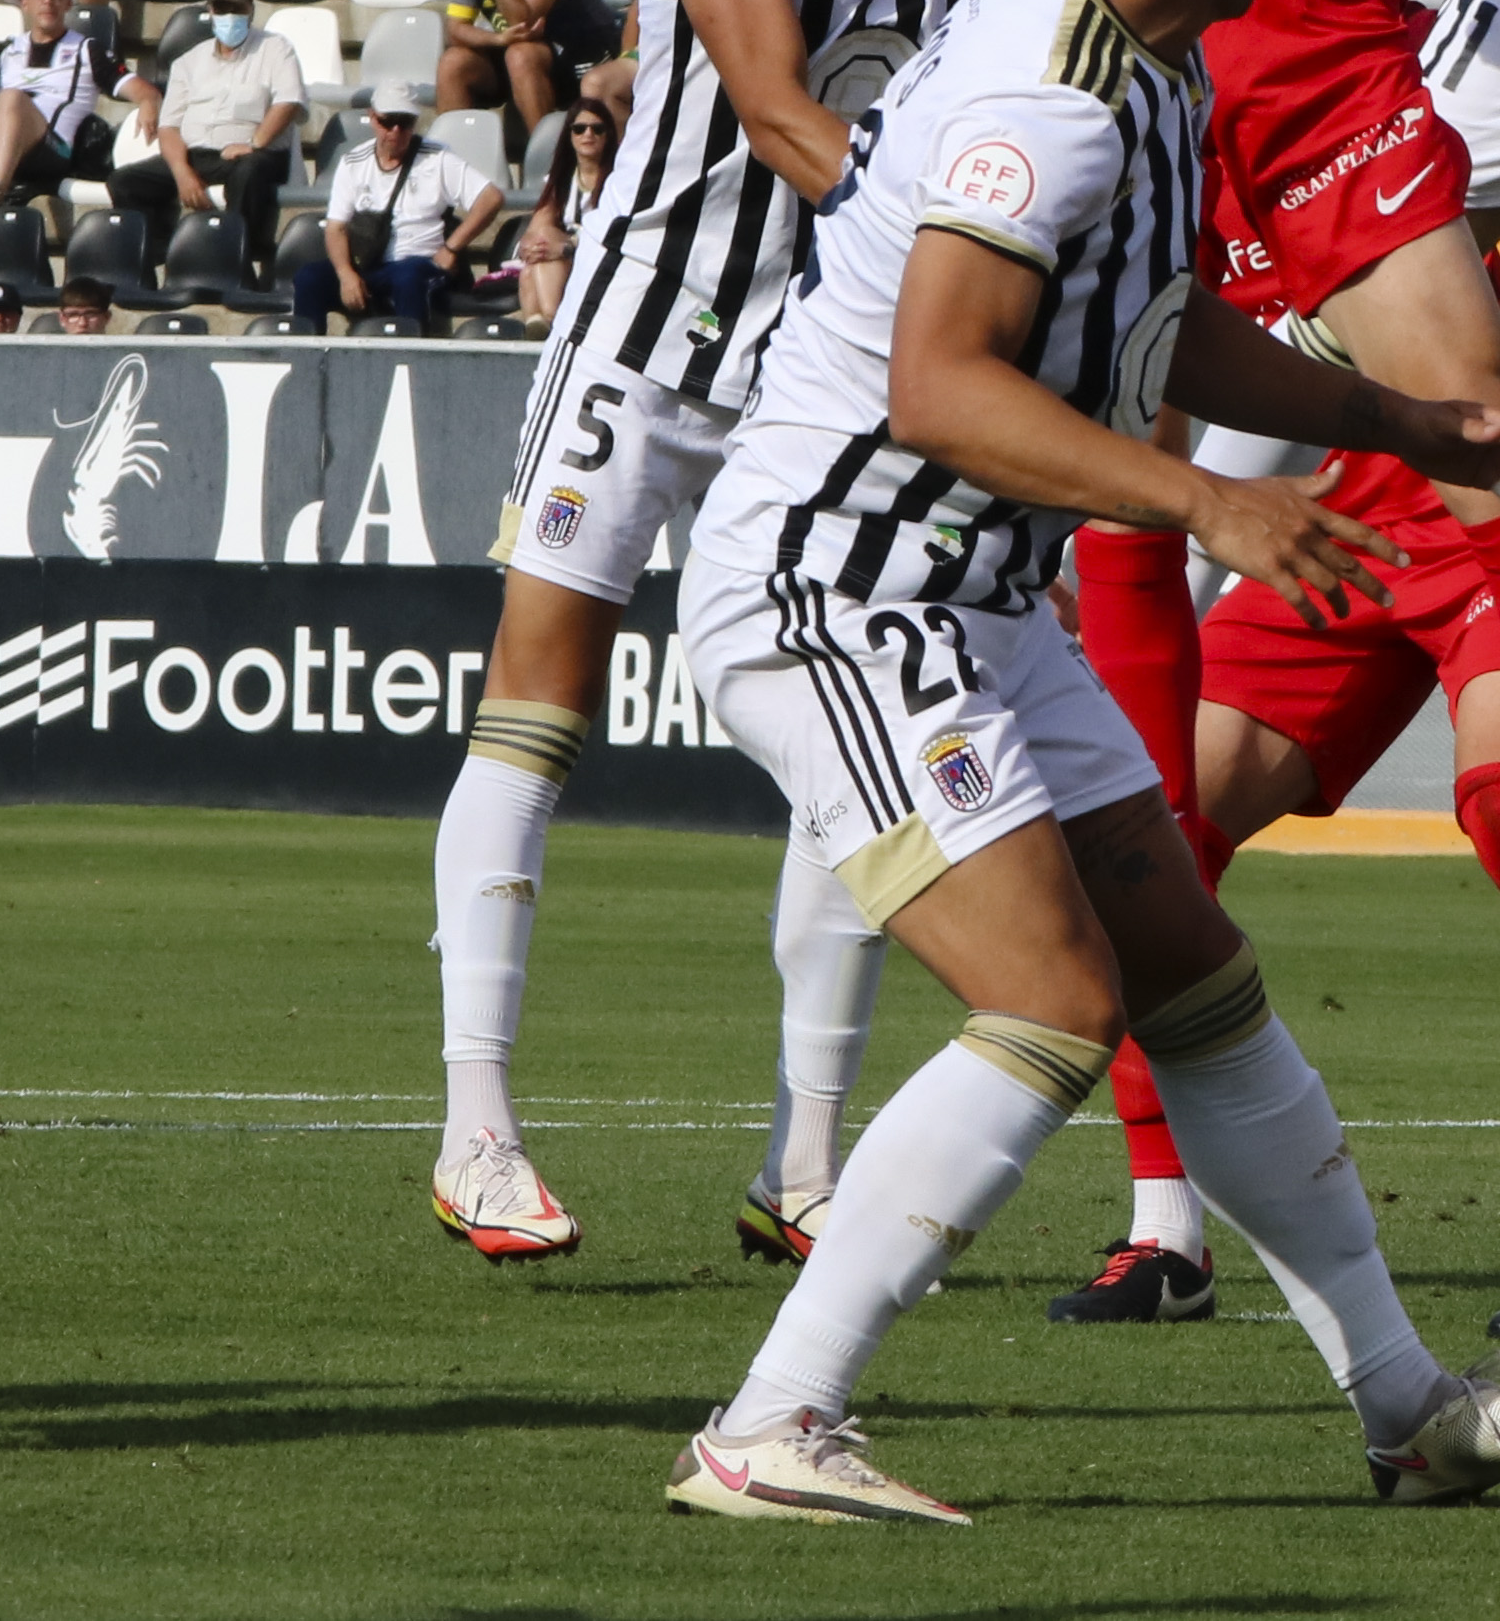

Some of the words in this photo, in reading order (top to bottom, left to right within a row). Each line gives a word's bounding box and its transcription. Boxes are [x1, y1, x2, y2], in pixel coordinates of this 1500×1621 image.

[1280, 165, 1335, 211] GRAN
[1334, 129, 1403, 176] PLAZA
[210, 361, 437, 565] LA
[561, 383, 626, 472] 5
